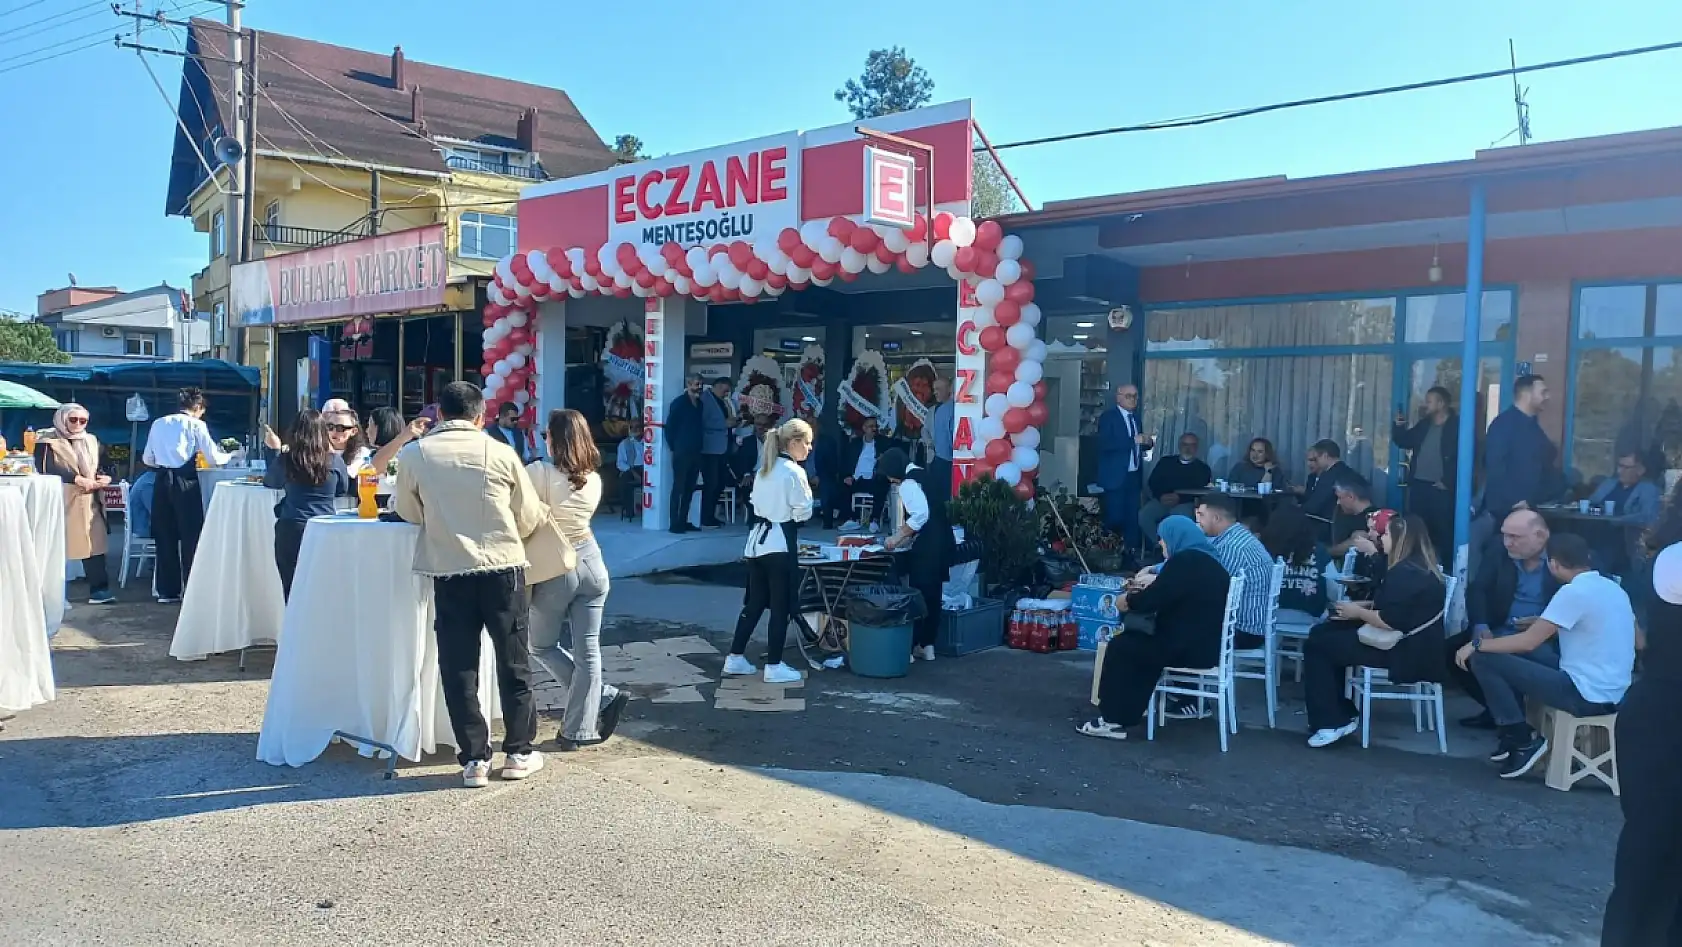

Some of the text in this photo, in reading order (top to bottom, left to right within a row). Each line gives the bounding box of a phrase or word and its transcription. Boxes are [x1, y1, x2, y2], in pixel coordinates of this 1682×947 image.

[615, 146, 788, 224] ECZANE
[879, 165, 905, 214] E
[641, 212, 754, 246] MENTEŞOĞLU
[279, 241, 444, 307] BUHARA MARKET
